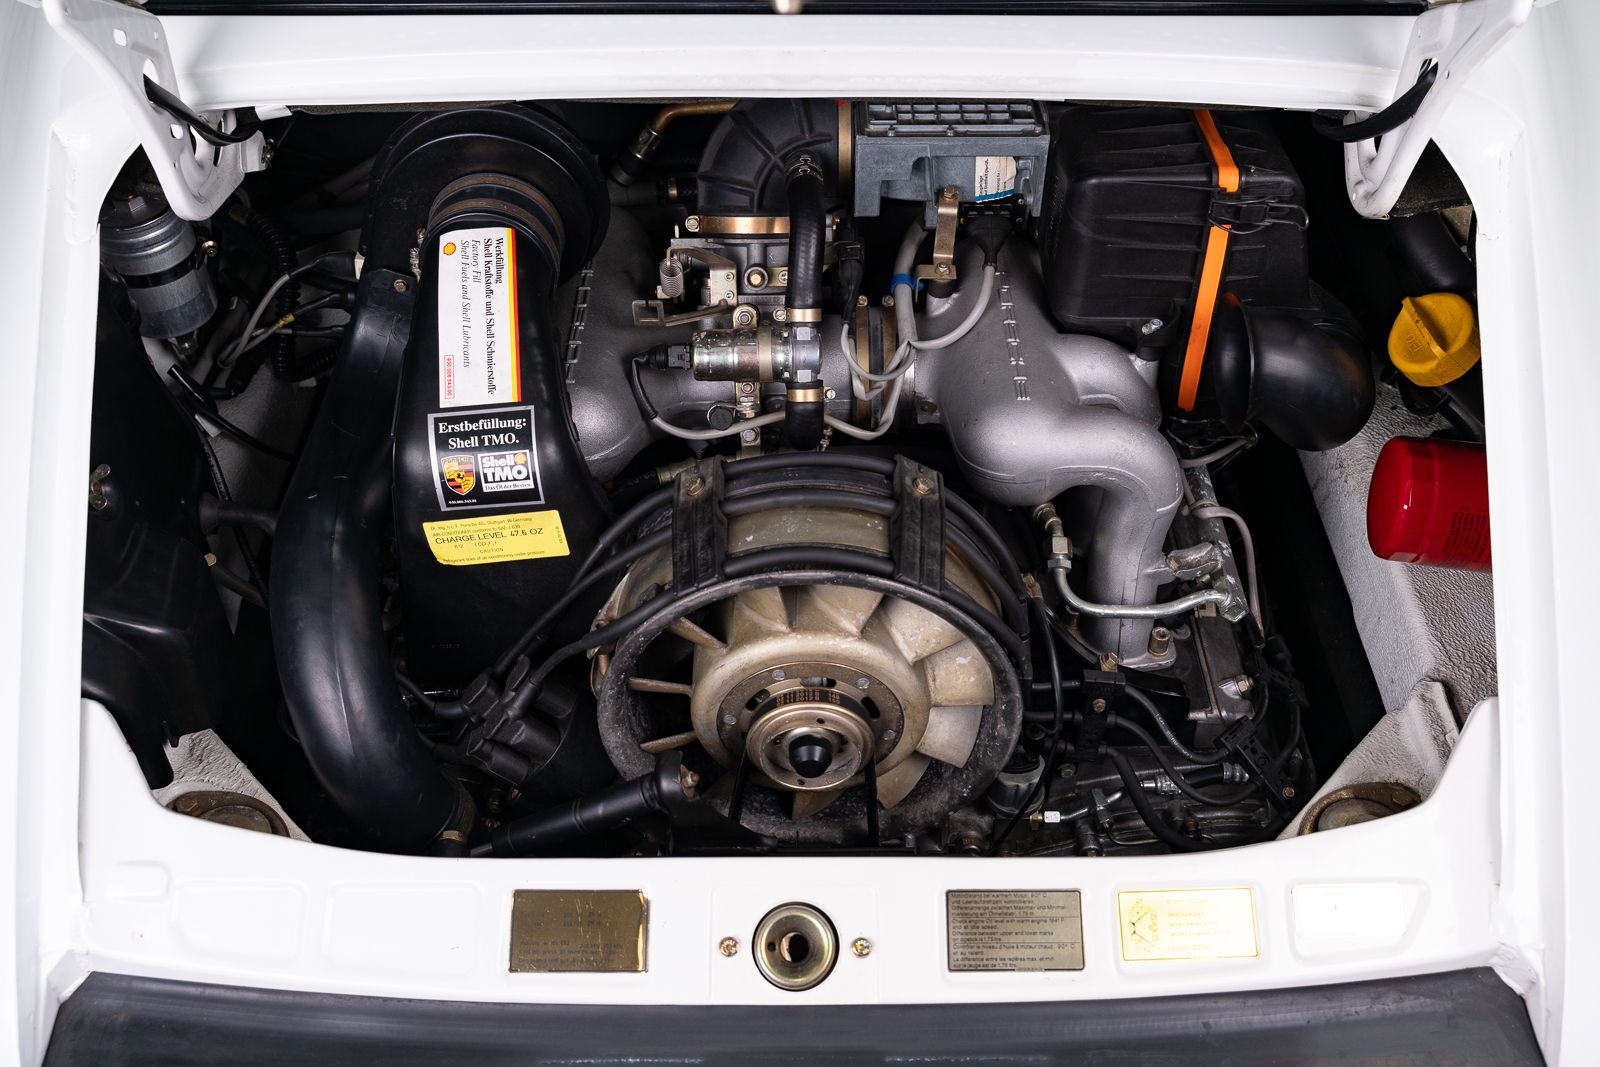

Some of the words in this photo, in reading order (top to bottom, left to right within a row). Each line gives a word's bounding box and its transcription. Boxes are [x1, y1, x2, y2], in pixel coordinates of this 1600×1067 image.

[460, 240, 470, 260] Shell
[470, 239, 481, 268] Factory
[484, 238, 493, 258] Shell
[494, 238, 504, 284] Werkfüllung
[461, 262, 470, 282] Fuels
[472, 270, 482, 283] Fill
[484, 260, 494, 299] Kraftstoffe
[462, 284, 471, 300] and
[462, 302, 472, 322] Shell
[486, 301, 494, 316] und
[486, 318, 495, 338] Shell
[462, 325, 472, 368] Lubricants
[486, 340, 496, 395] Schmierstoffe
[438, 416, 527, 434] Erstbefüllung:
[448, 436, 479, 450] Shell
[481, 432, 520, 446] TMO.
[482, 454, 514, 468] Shell
[484, 465, 528, 482] TMO
[435, 533, 476, 544] CHARGE
[478, 531, 507, 541] LEVEL
[530, 527, 544, 535] OZ
